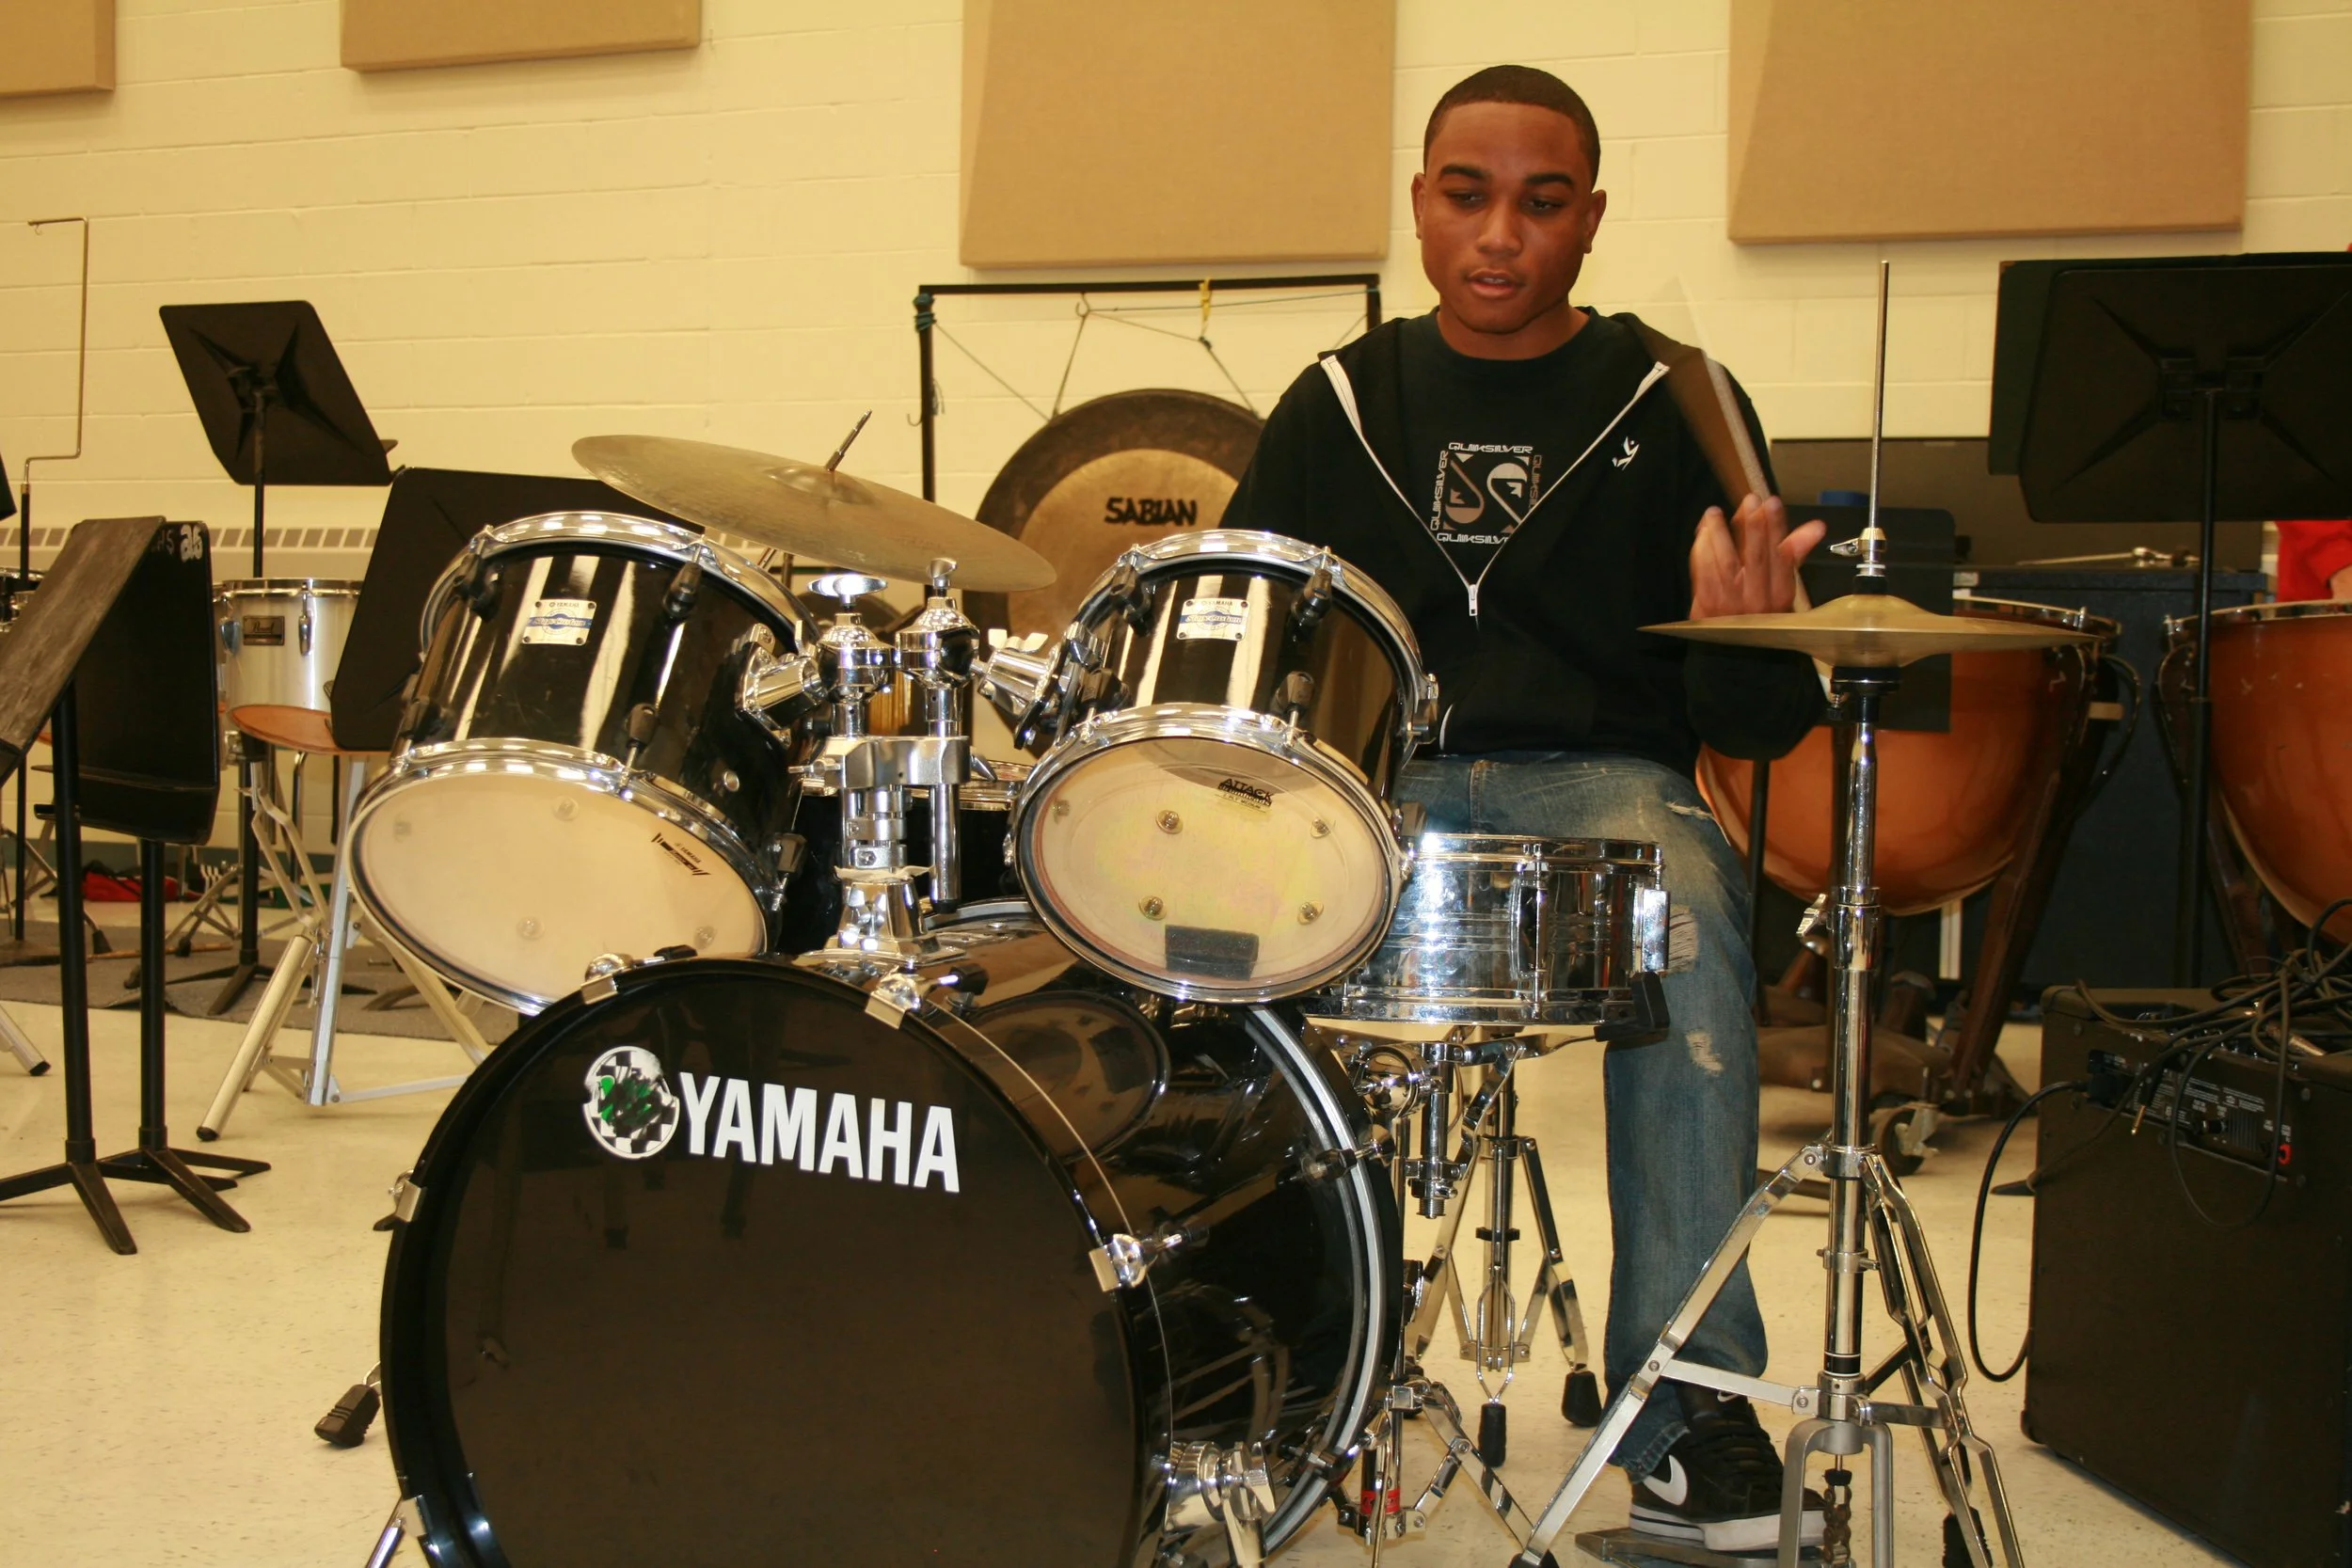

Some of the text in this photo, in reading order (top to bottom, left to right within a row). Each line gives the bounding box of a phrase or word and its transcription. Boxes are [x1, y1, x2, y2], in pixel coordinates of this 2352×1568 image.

[1449, 442, 1534, 453] QUIKSILVER
[1430, 450, 1449, 531] QUIKSILVER
[1528, 454, 1543, 509] QUIKSIL
[1104, 497, 1198, 527] SABIAN
[1436, 532, 1509, 545] QUIKSILV
[1221, 779, 1274, 801] ATTACK
[678, 1070, 961, 1194] YAMAHA
